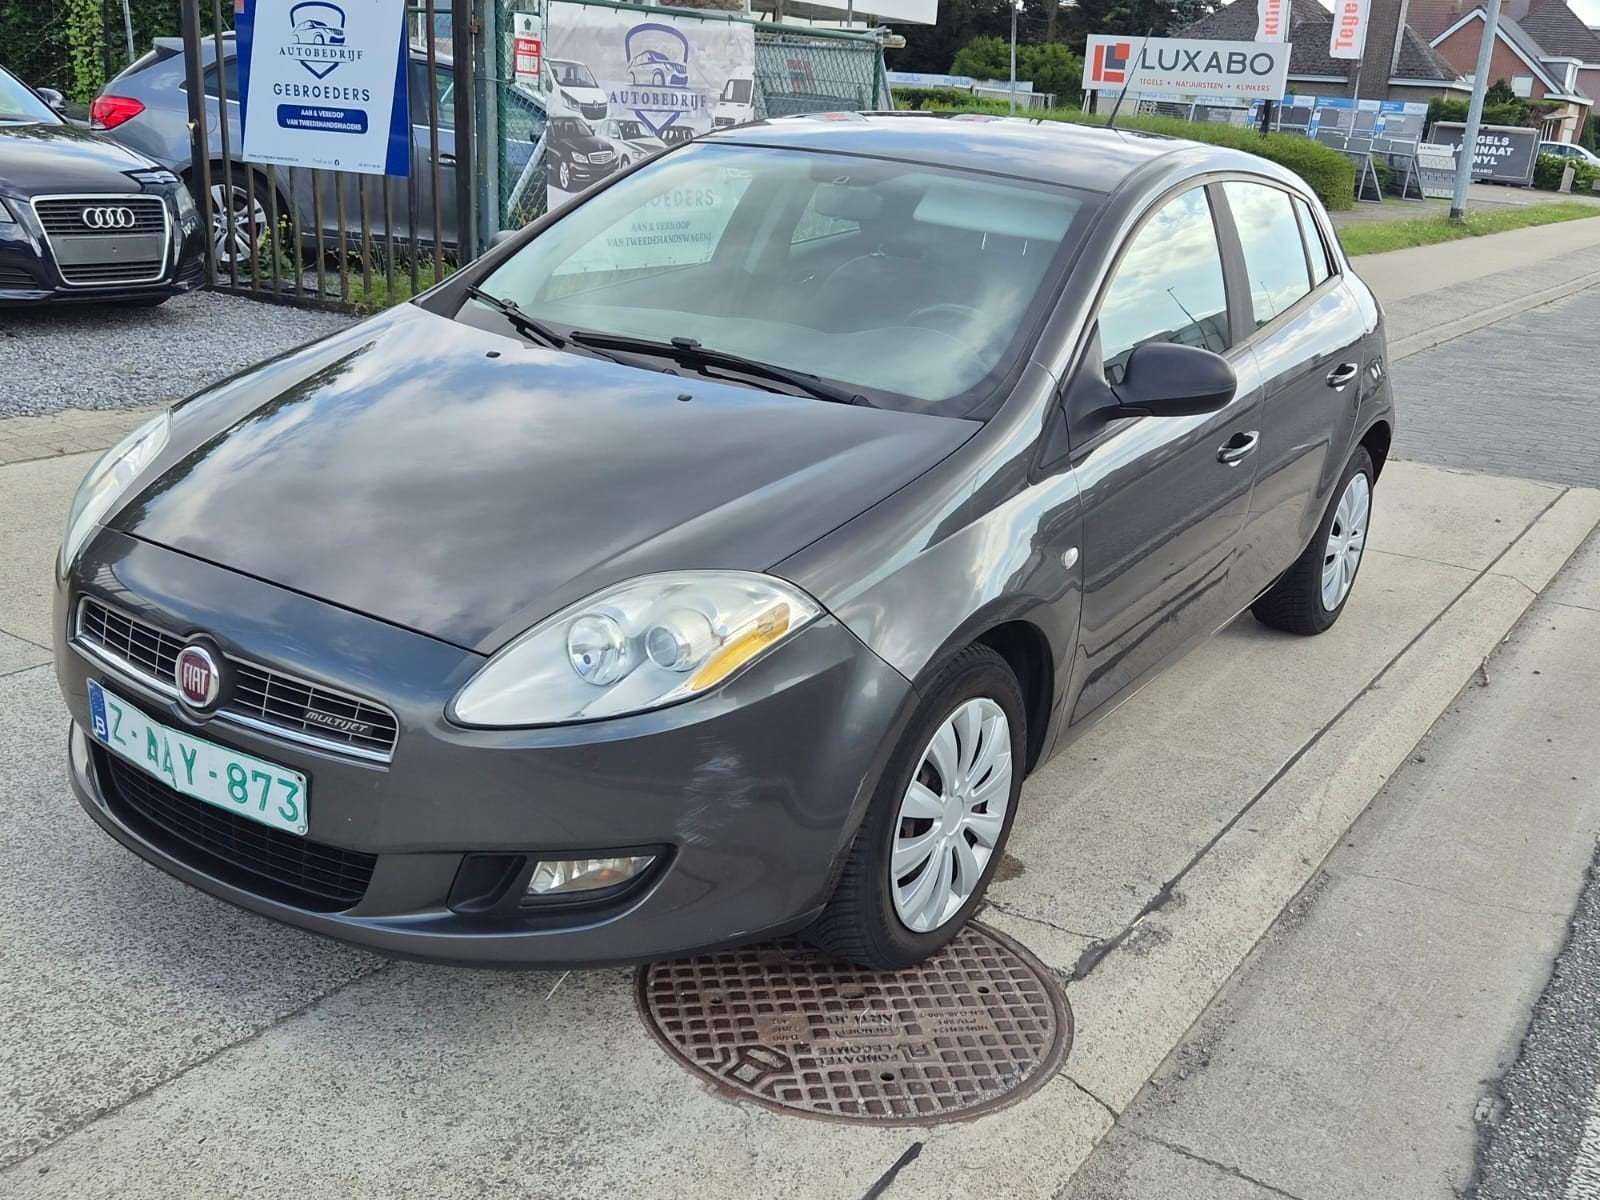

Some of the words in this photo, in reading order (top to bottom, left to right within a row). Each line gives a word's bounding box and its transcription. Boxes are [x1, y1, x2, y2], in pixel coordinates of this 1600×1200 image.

[518, 40, 537, 52] Alarm
[279, 47, 363, 61] AUTOBEDRIJF
[1140, 48, 1275, 76] LUXABO
[273, 83, 370, 101] GEBROEDERS
[1140, 78, 1163, 86] TEGELS
[1175, 81, 1223, 89] NATUURSTEEN
[1236, 84, 1270, 92] KLINKERS
[609, 91, 707, 110] AUTOBEDRIJF
[301, 109, 313, 117] AAN
[318, 111, 344, 119] VERKOOP
[286, 118, 299, 126] VAN
[631, 222, 648, 232] AAN
[656, 220, 690, 231] VERKOOP
[607, 238, 624, 248] VAN
[184, 662, 209, 695] FIAT
[95, 717, 105, 735] B
[305, 711, 369, 732] MULTIJET
